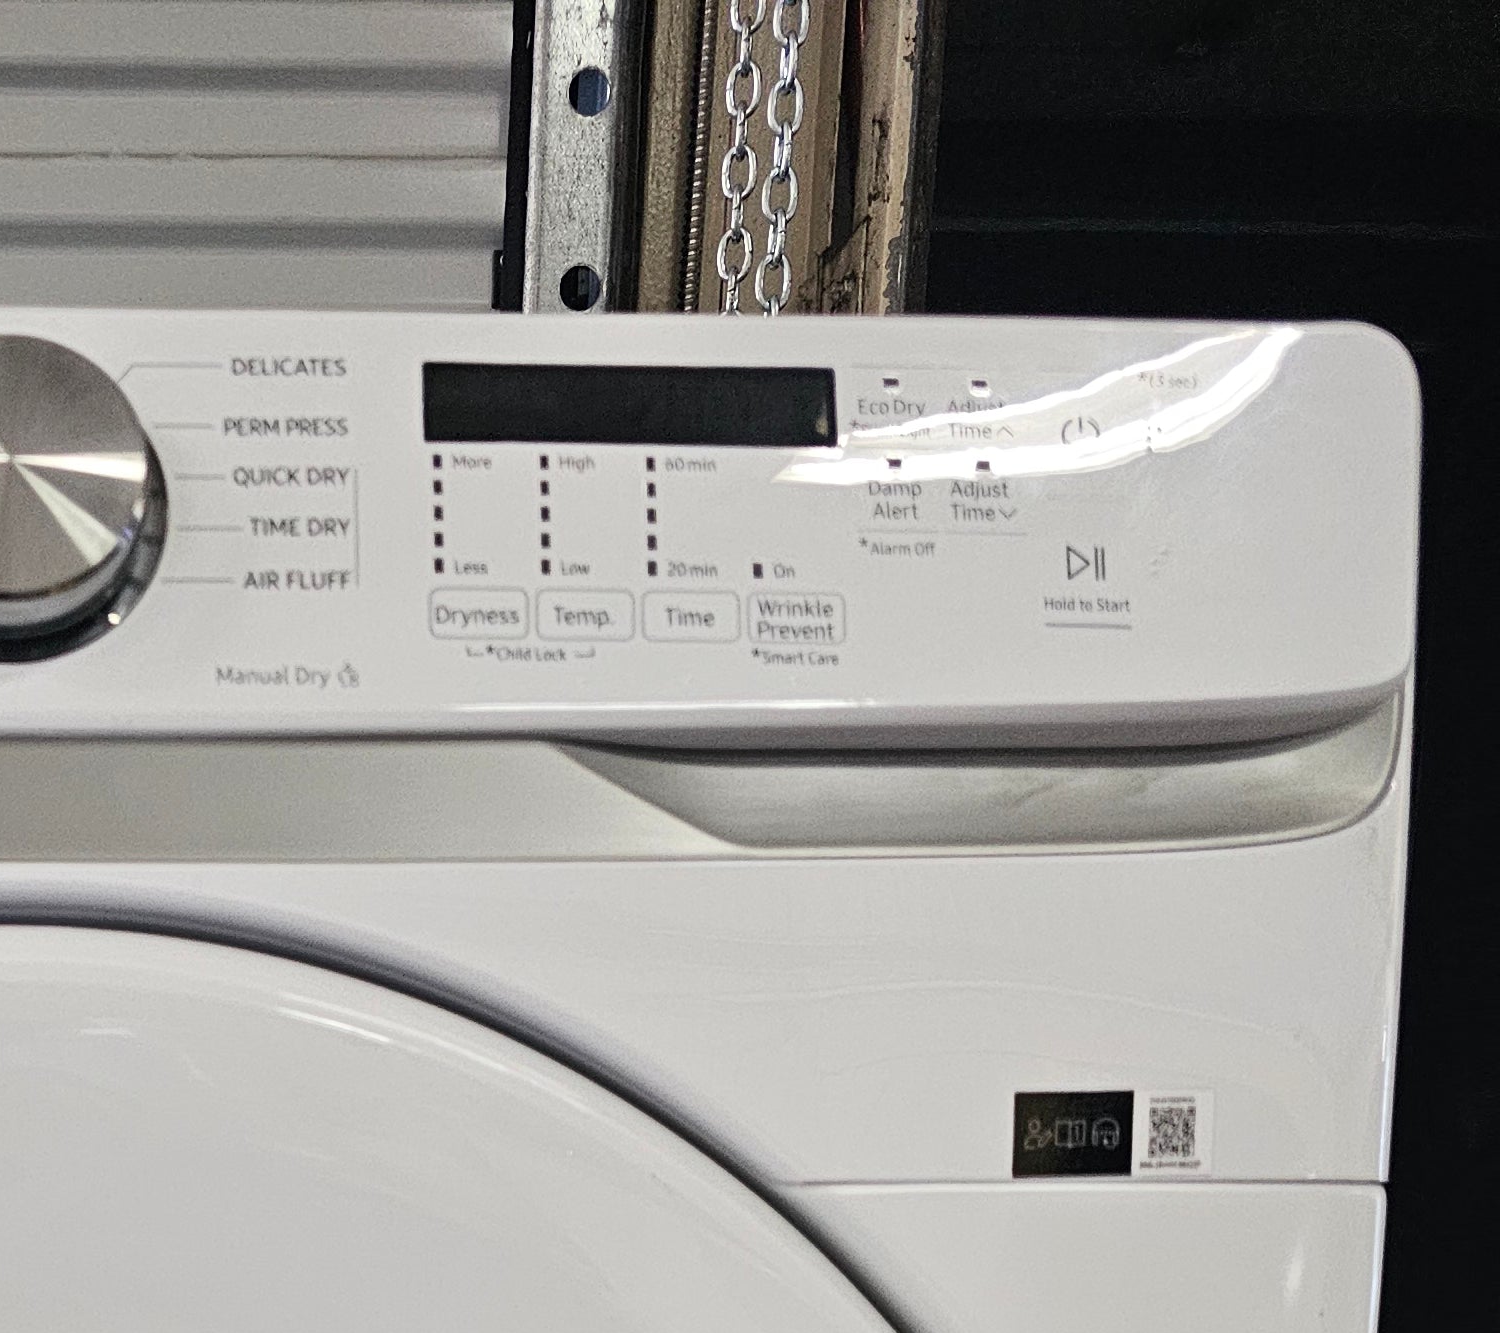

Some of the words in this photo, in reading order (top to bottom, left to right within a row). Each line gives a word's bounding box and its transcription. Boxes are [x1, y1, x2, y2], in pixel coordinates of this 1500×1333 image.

[230, 357, 347, 377] DELICATES
[857, 398, 890, 416] Eco
[893, 398, 926, 417] Dry
[223, 417, 281, 437] PERM
[285, 417, 349, 437] PRESS
[946, 420, 994, 440] Time
[451, 455, 493, 470] More
[558, 455, 596, 474] High
[232, 466, 300, 489] QUICK
[306, 466, 350, 486] DRY
[866, 482, 924, 500] Damp
[950, 479, 1009, 501] Adjust
[873, 501, 918, 520] Alert
[949, 503, 996, 523] Time
[250, 517, 300, 537] TIME
[306, 516, 350, 537] DRY
[913, 541, 936, 557] Off
[454, 560, 489, 575] Less
[560, 562, 591, 576] Low
[773, 562, 796, 579] On
[243, 569, 280, 590] AIR
[285, 569, 351, 591] FLUFF
[756, 599, 835, 617] Wrinkle
[1043, 597, 1076, 611] Hold
[1078, 598, 1093, 612] to
[1096, 597, 1130, 613] Start
[434, 604, 520, 629] Dryness
[553, 604, 615, 628] Temp.
[665, 607, 716, 628] Time
[756, 622, 835, 641] Prevent
[535, 648, 567, 662] Lock
[807, 651, 840, 666] Care
[215, 666, 290, 686] Manual
[294, 665, 331, 689] Dry
